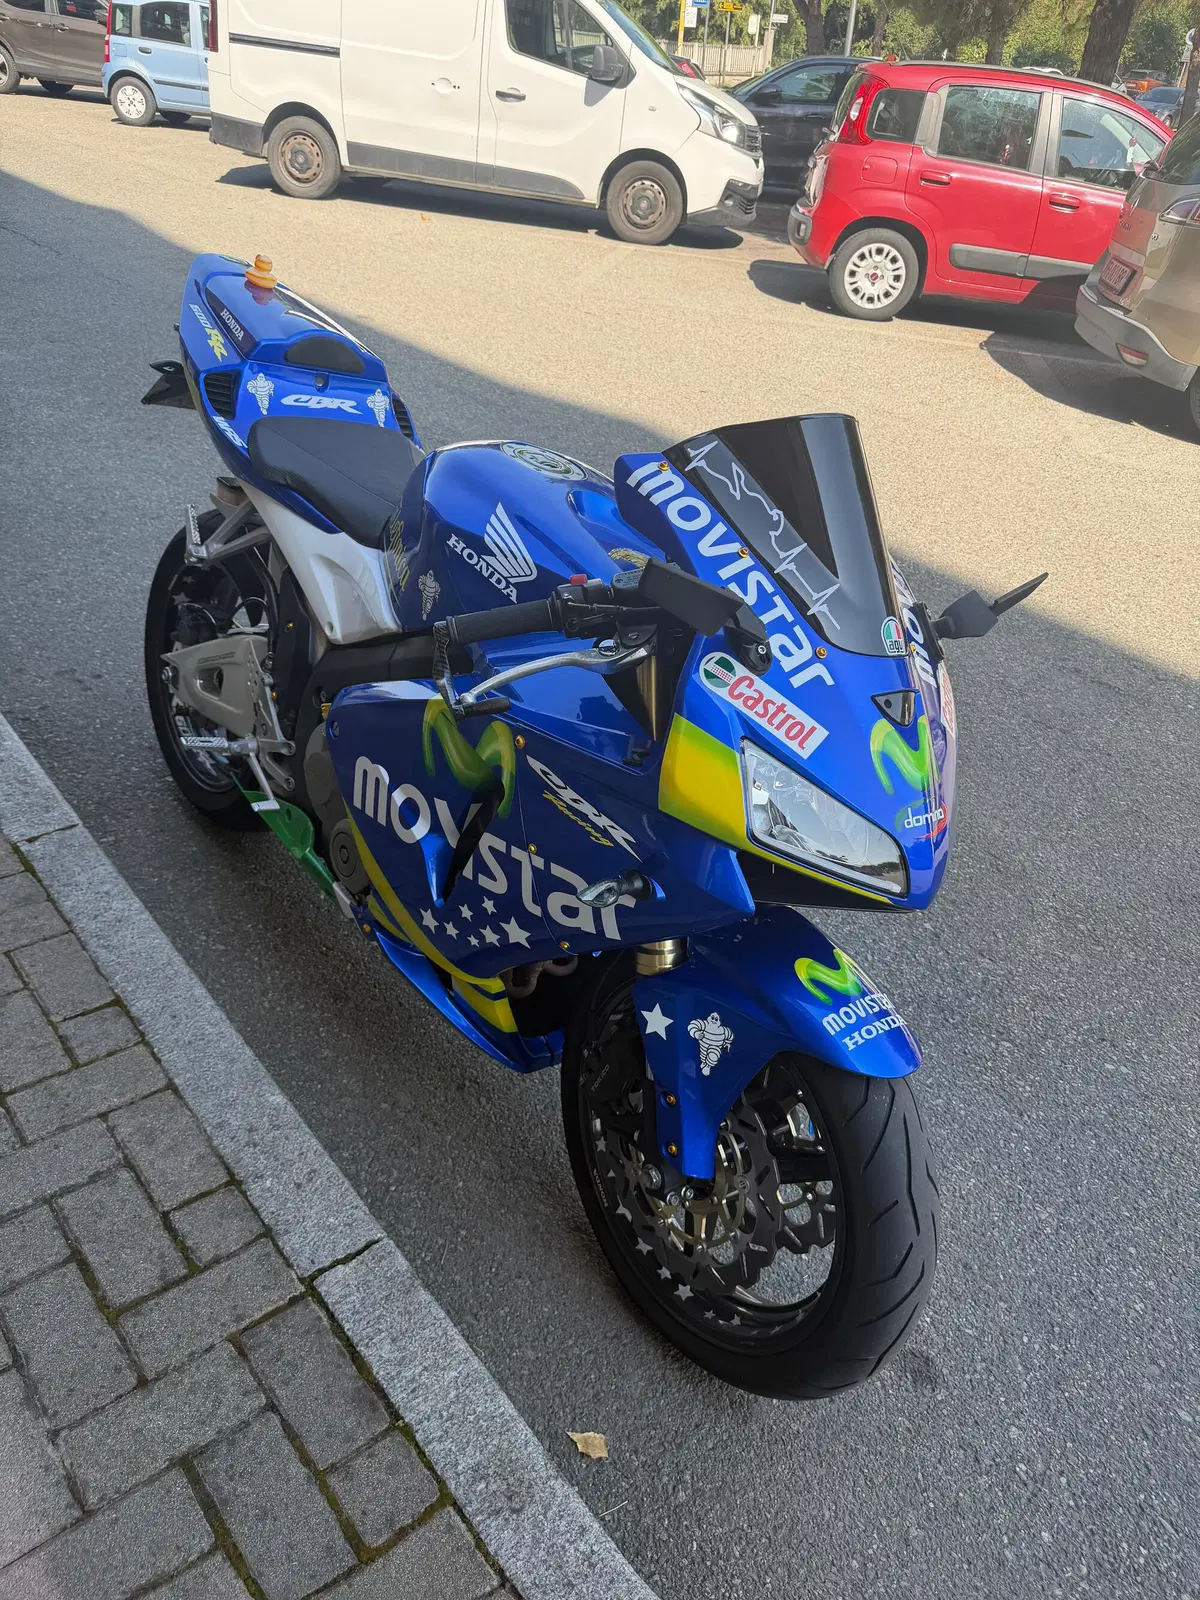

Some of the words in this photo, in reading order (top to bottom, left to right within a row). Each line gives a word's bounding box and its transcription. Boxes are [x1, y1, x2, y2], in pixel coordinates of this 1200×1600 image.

[220, 308, 244, 341] HONDA
[280, 394, 363, 415] CBR
[445, 533, 518, 604] HONDA
[626, 461, 835, 689] movistar
[728, 675, 817, 750] Castrol
[526, 754, 643, 864] CBR
[842, 1014, 908, 1051] HONDA
